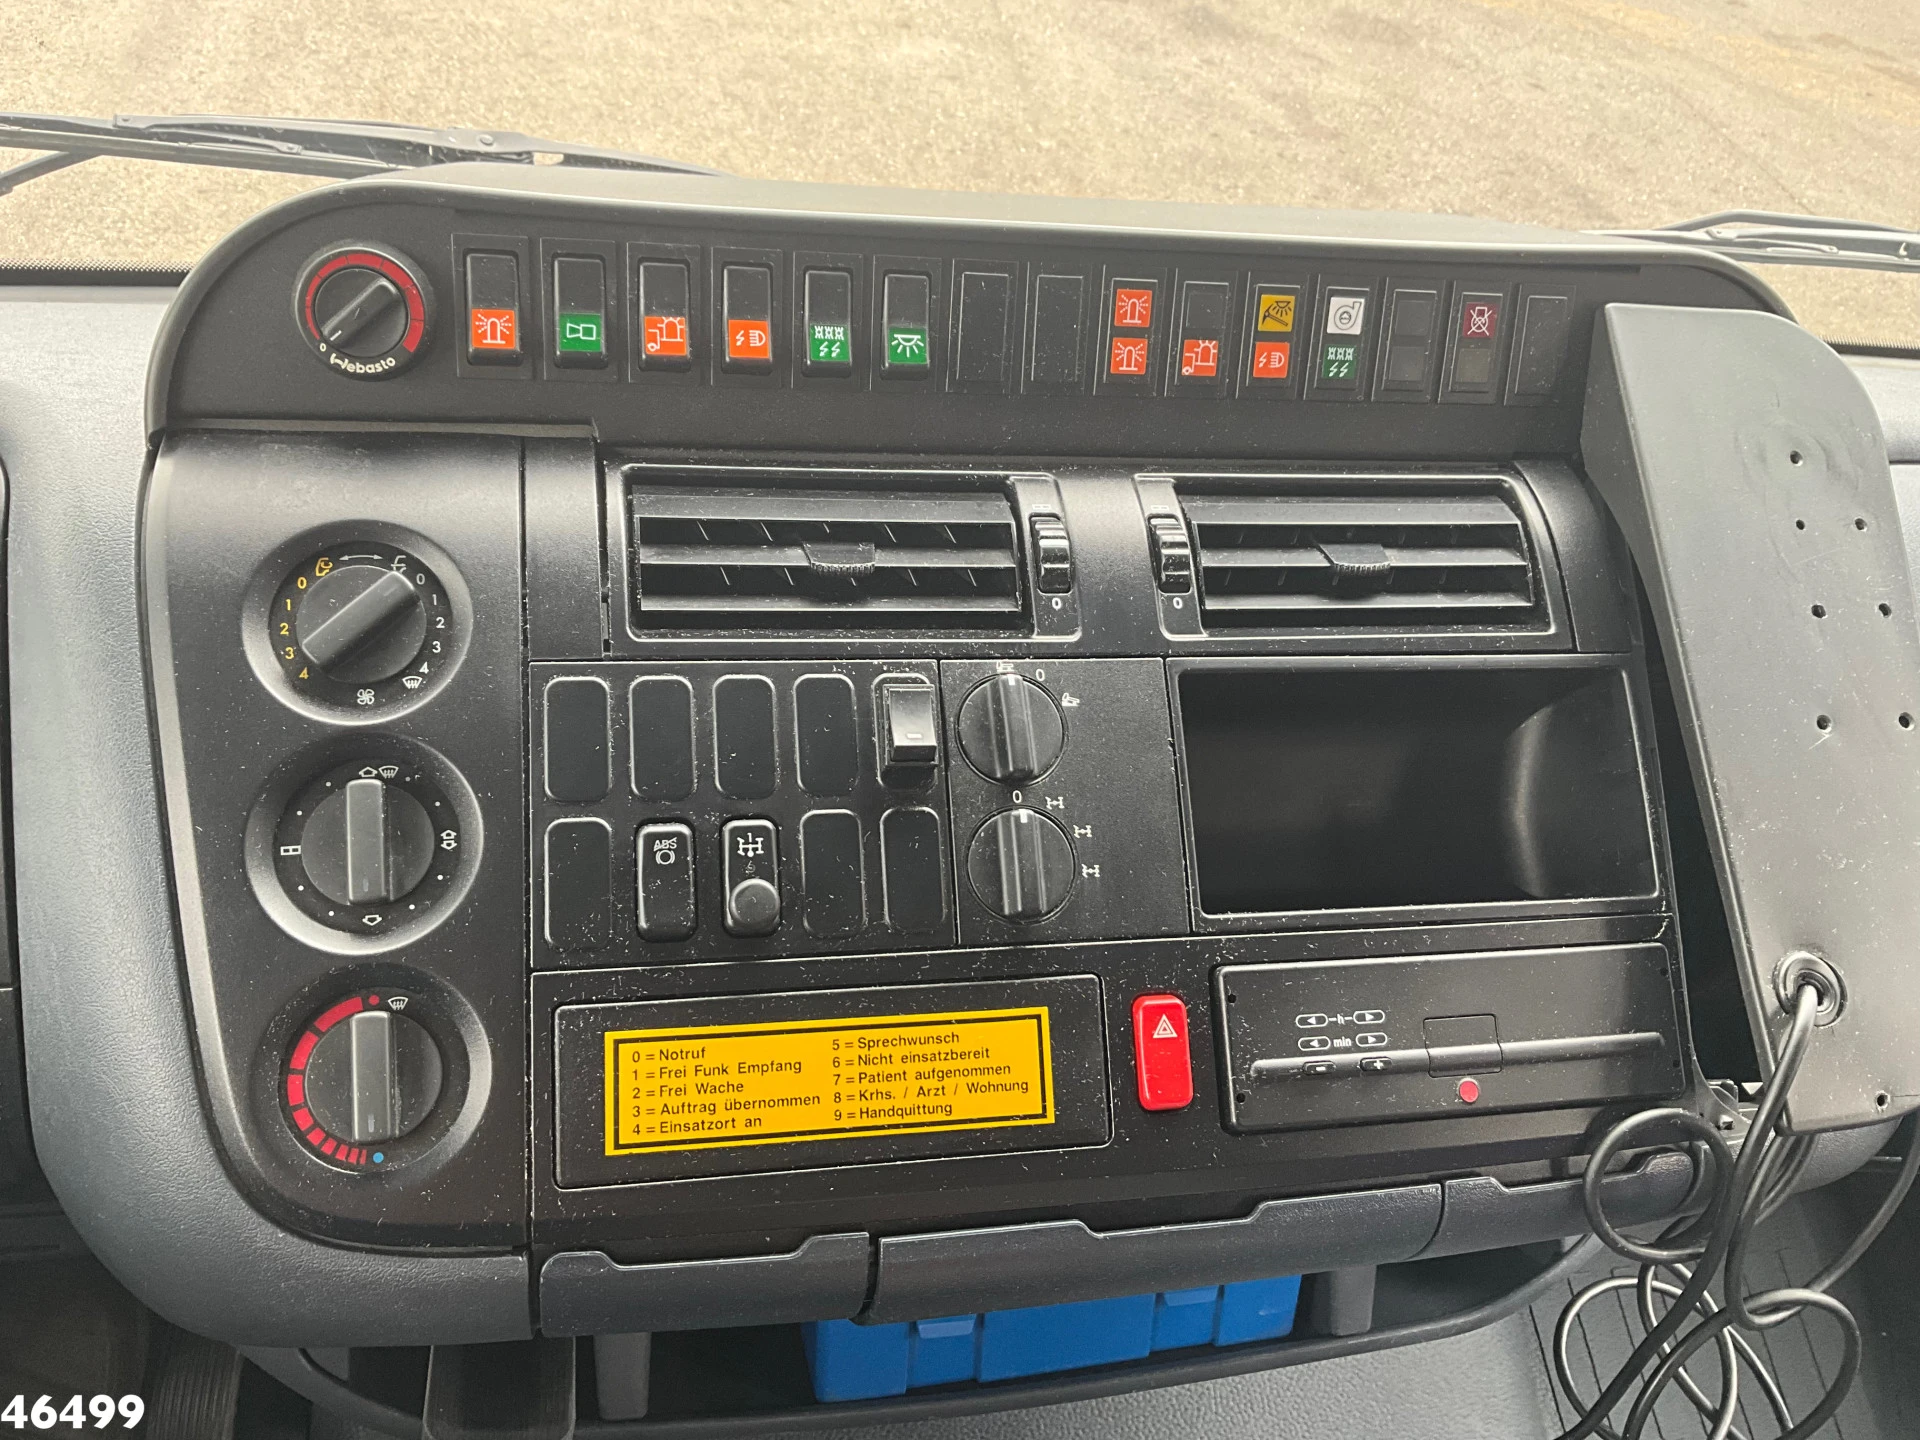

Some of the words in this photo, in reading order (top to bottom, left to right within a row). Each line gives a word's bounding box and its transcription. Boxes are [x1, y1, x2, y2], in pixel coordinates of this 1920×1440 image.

[297, 577, 307, 589] 0
[416, 574, 425, 584] 0
[286, 599, 291, 610] 1
[432, 594, 437, 605] 1
[280, 623, 289, 634] 2
[436, 617, 445, 628] 2
[432, 641, 441, 652] 3
[285, 648, 294, 659] 3
[299, 667, 309, 679] 4
[419, 662, 429, 674] 4
[857, 1032, 959, 1051] Sprechwunsch
[1333, 1036, 1352, 1047] min
[659, 1046, 706, 1061] Notruf
[858, 1053, 893, 1066] Nicht
[901, 1047, 990, 1064] einsatzbereit
[659, 1066, 687, 1079] Frei
[694, 1063, 729, 1077] Funk
[738, 1061, 802, 1076] Empfang
[859, 1070, 907, 1084] Patient
[915, 1064, 1011, 1082] aufgenommen
[660, 1084, 687, 1097] Frei
[695, 1081, 744, 1095] Wache
[859, 1088, 896, 1101] Krhs.
[917, 1085, 945, 1098] Arzt
[966, 1080, 1028, 1094] Wohnung
[660, 1102, 716, 1116] Auftrag
[725, 1095, 820, 1111] übernommen
[860, 1103, 952, 1119] Handquittung
[660, 1117, 736, 1134] Einsatzort
[744, 1116, 762, 1127] an
